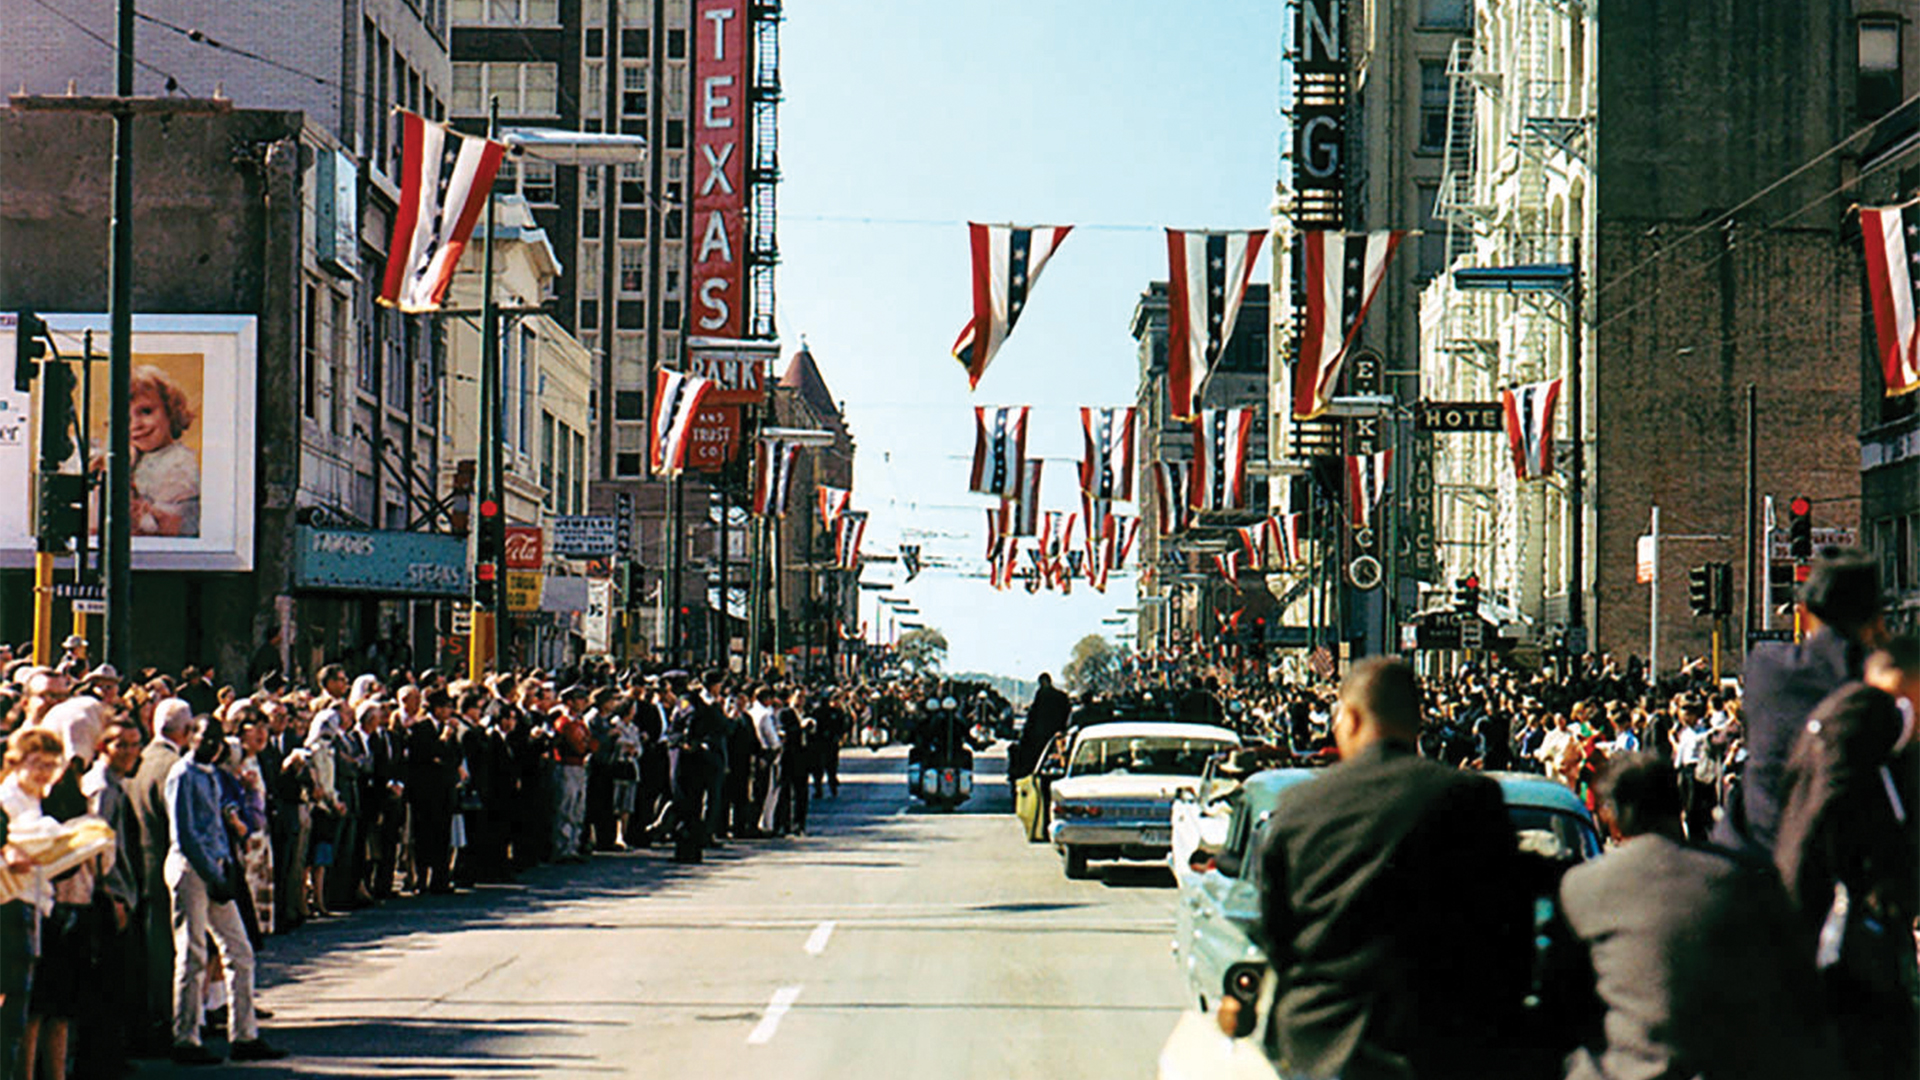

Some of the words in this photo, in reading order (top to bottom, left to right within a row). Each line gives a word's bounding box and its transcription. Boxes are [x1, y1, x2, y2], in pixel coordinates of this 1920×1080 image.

[699, 8, 734, 331] TEXAS
[691, 358, 757, 390] BANK
[692, 427, 732, 442] TRUST
[1425, 409, 1497, 428] HOTE
[1415, 439, 1432, 569] MAURICE
